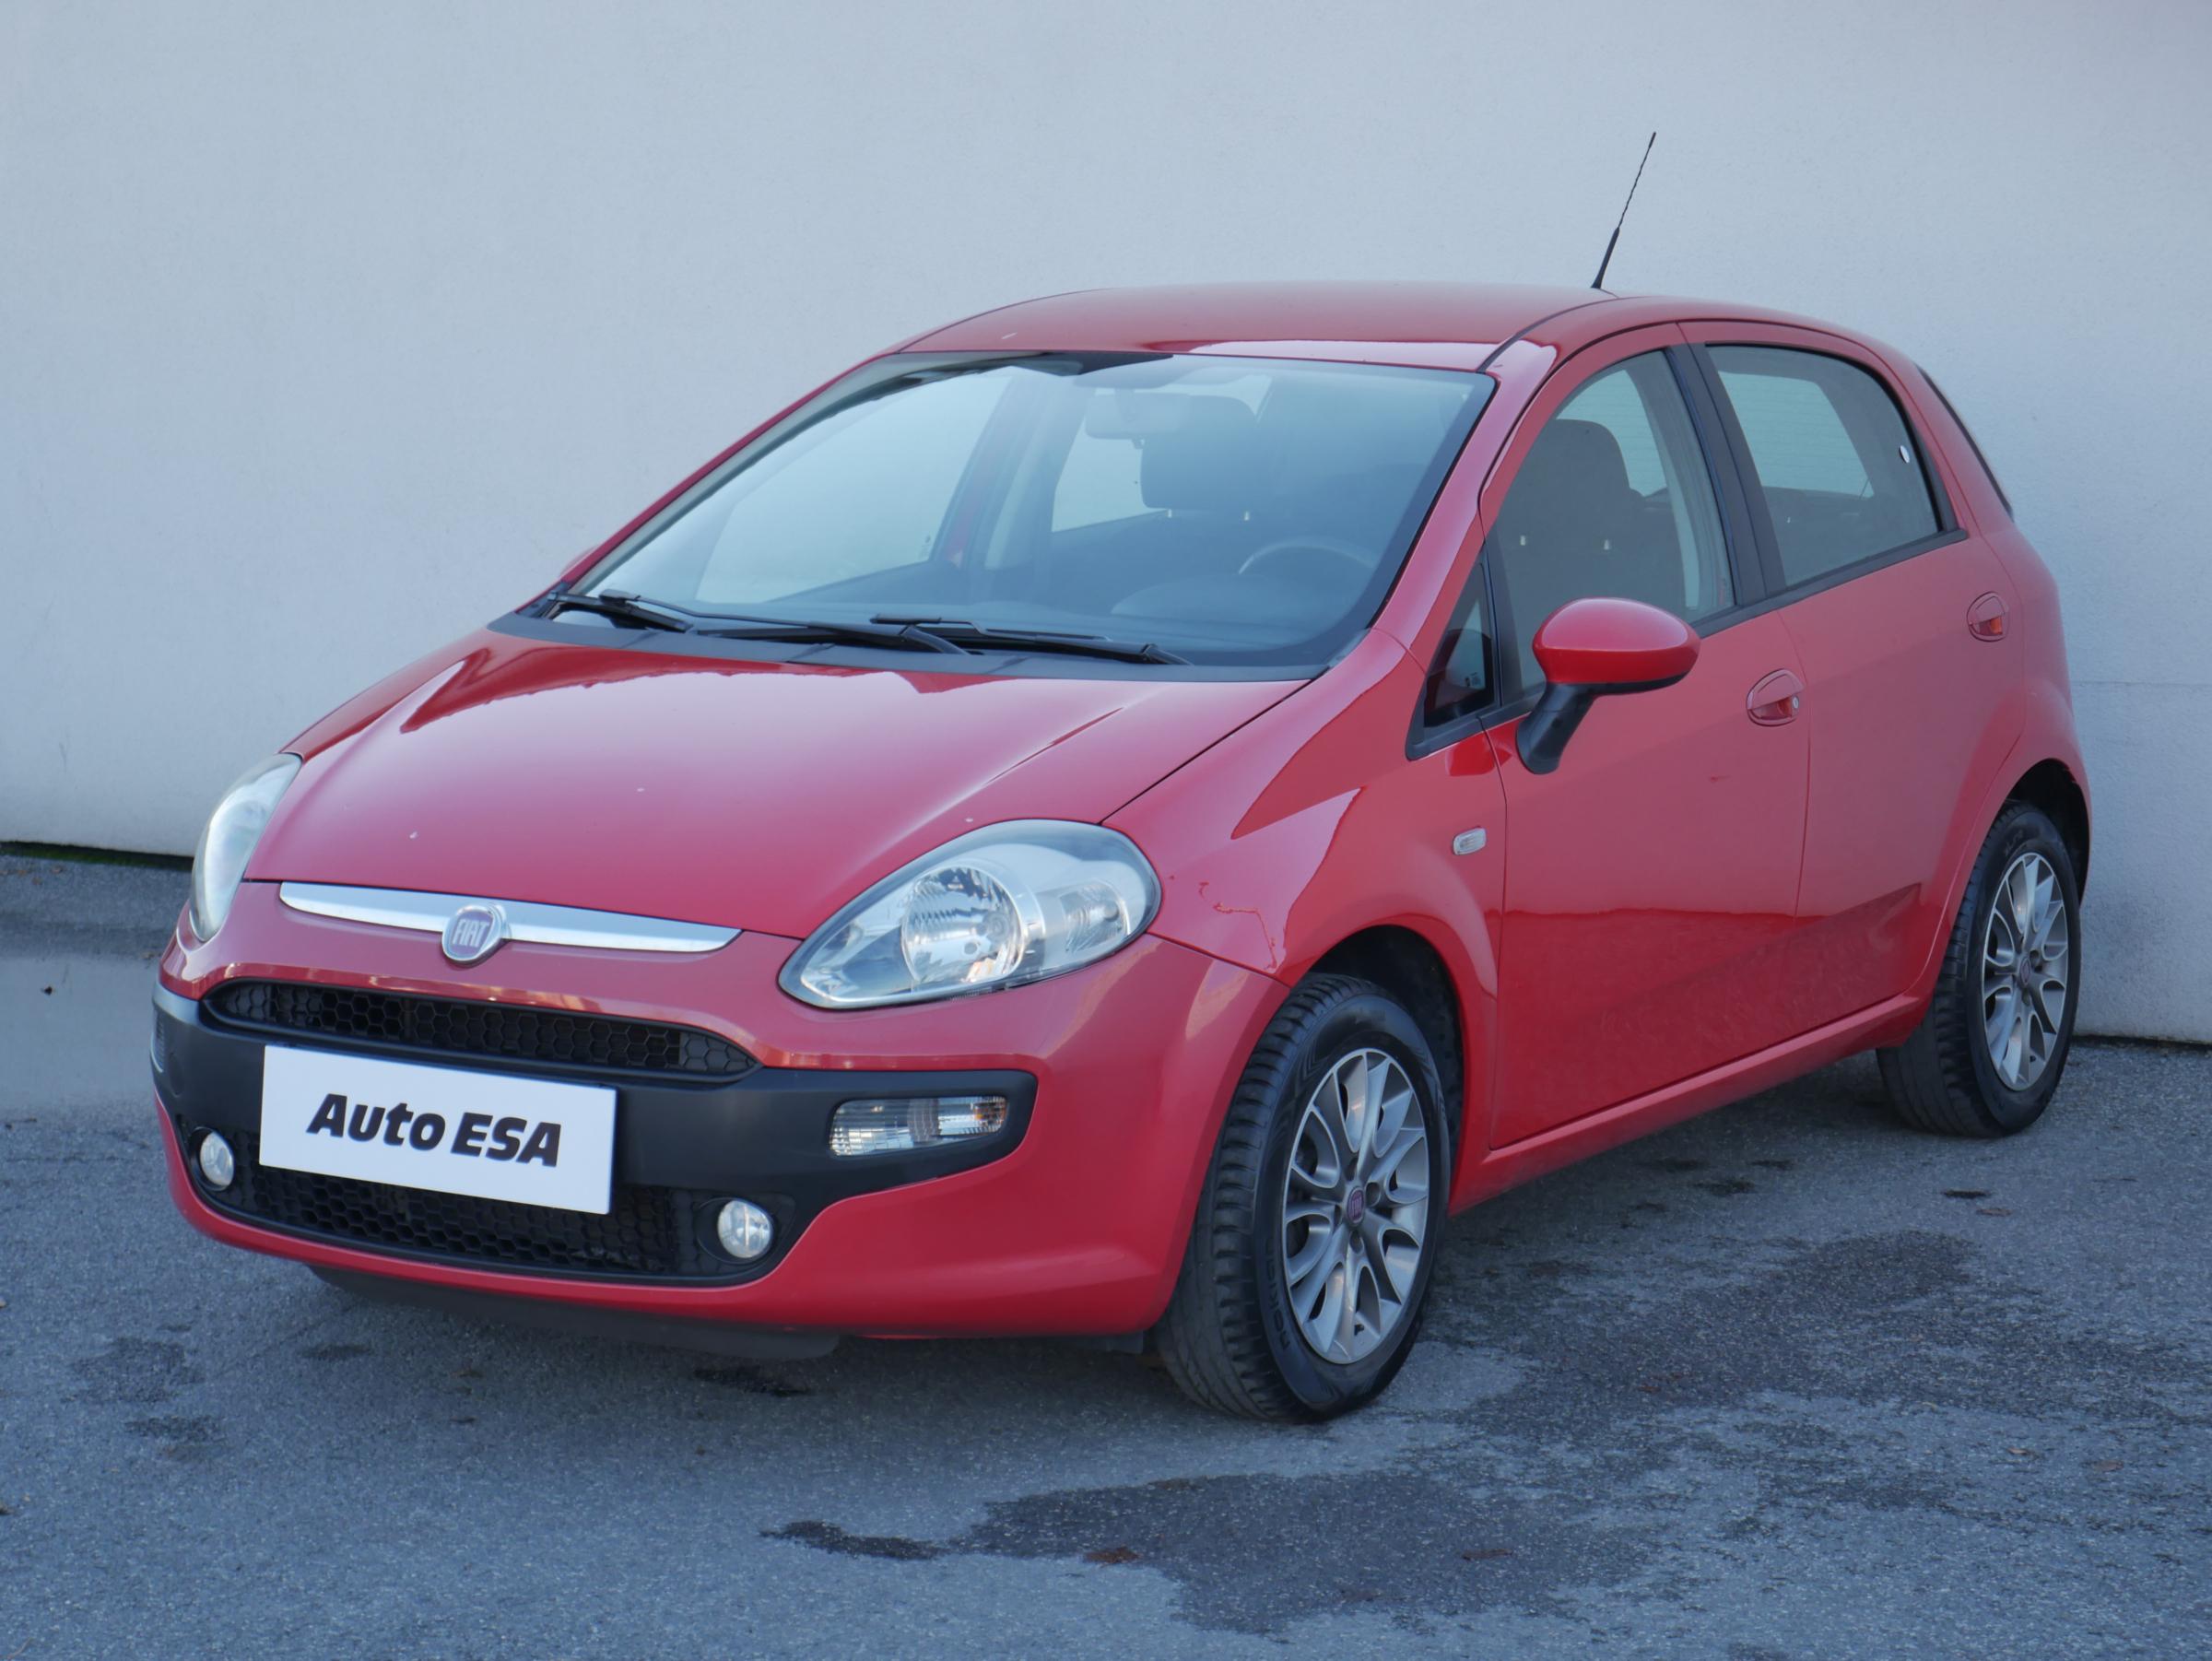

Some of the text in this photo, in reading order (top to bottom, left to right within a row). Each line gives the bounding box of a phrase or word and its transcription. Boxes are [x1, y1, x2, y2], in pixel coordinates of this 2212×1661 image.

[453, 920, 489, 948] FIAT
[306, 1093, 561, 1167] Auto ESA
